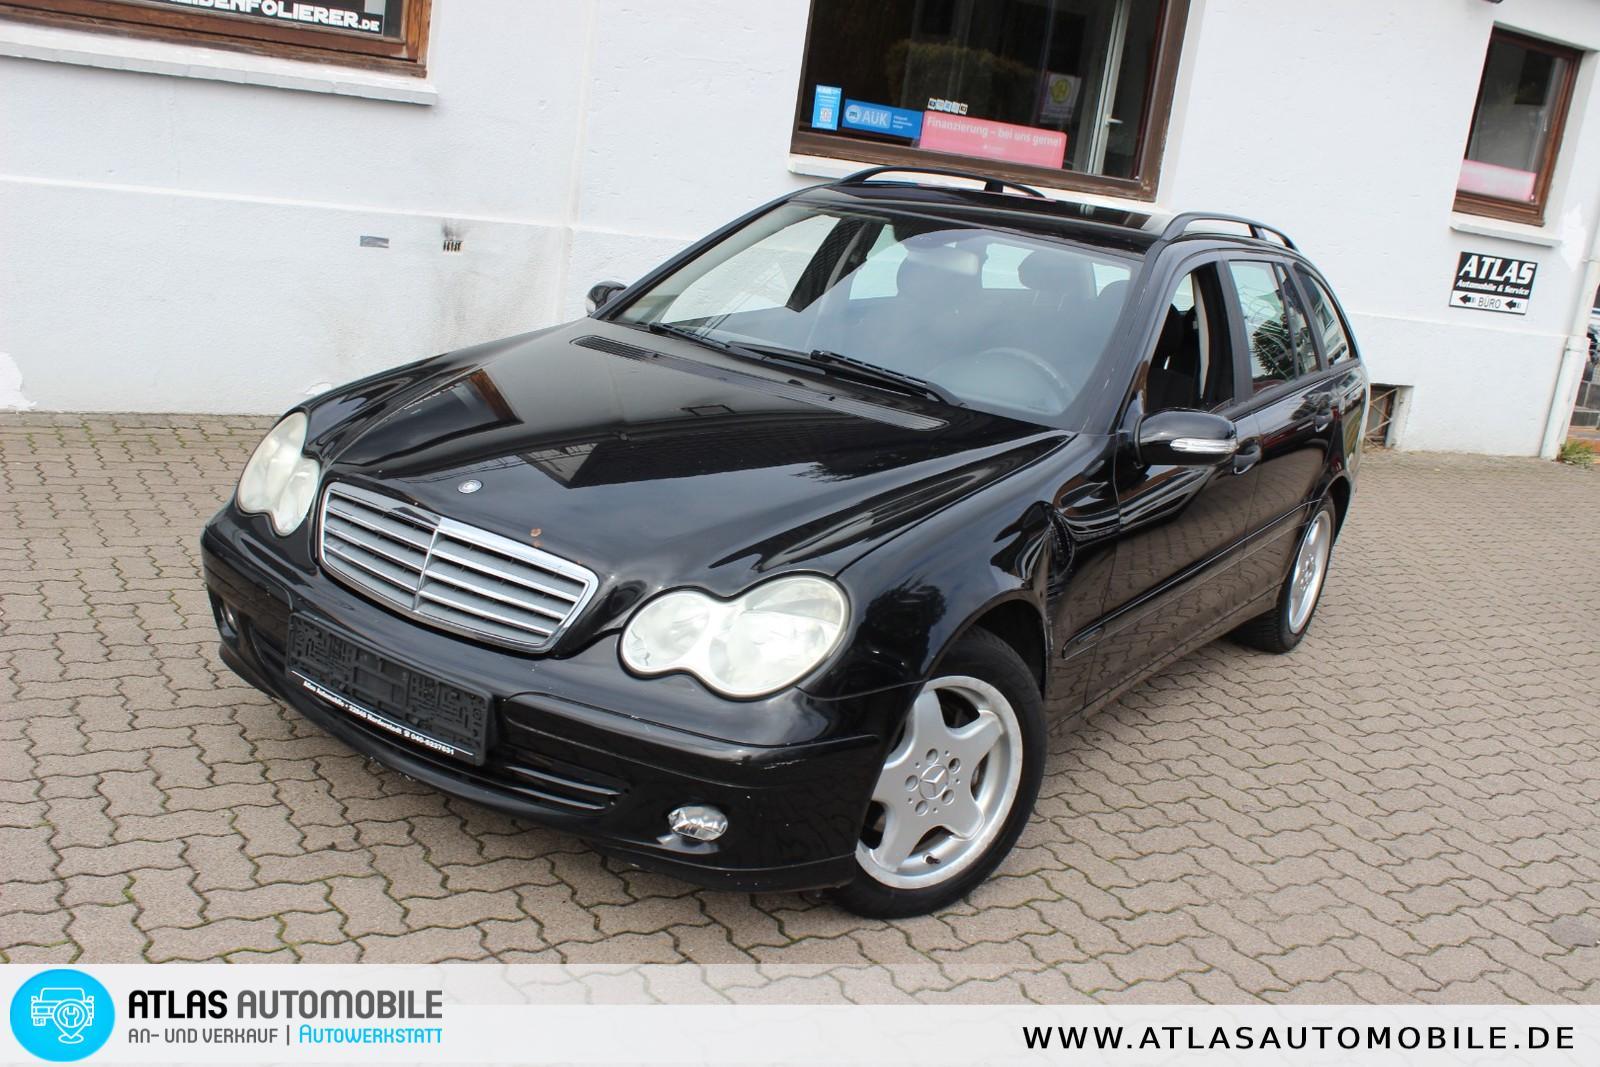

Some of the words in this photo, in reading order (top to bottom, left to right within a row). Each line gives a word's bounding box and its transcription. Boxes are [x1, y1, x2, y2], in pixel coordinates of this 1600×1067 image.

[863, 109, 888, 127] AUK
[927, 117, 989, 138] Finanzierung
[1459, 255, 1536, 284] ATLAS
[1478, 296, 1502, 309] BÜRO
